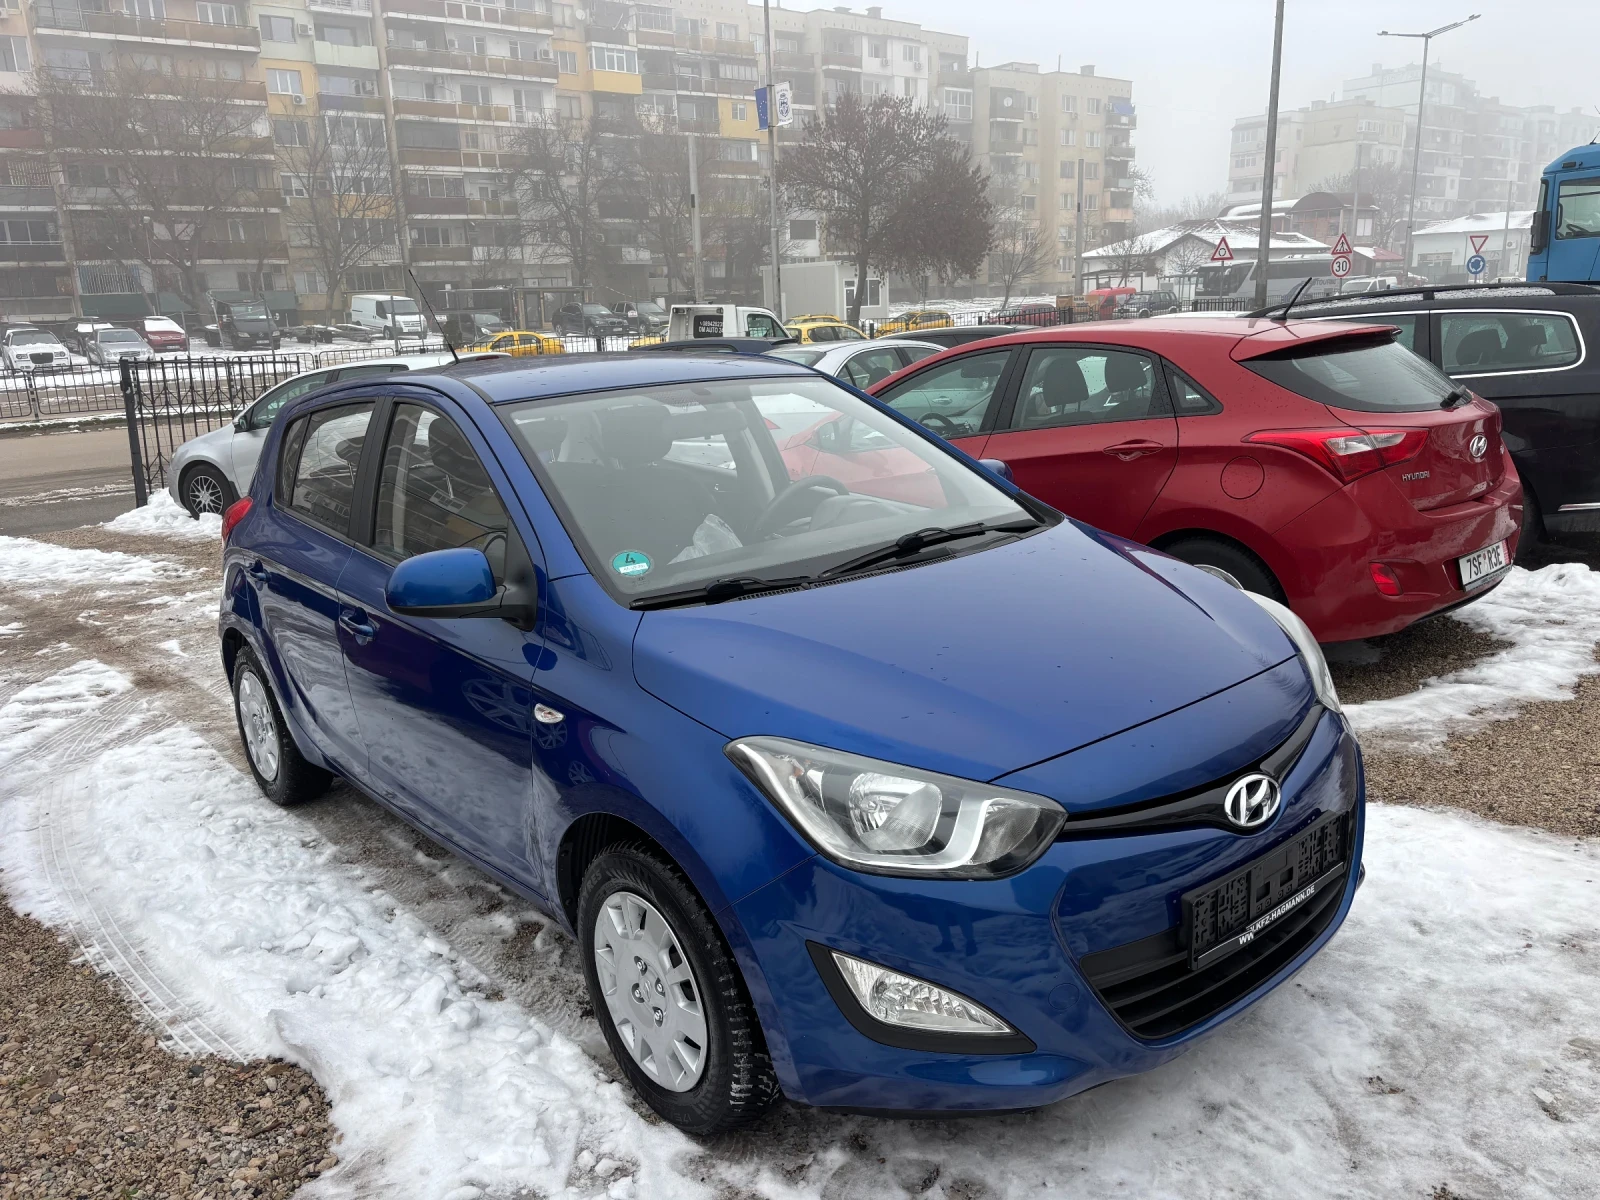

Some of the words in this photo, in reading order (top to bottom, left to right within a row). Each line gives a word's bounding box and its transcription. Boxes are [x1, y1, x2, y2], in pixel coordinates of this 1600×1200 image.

[1335, 260, 1348, 272] 30
[1402, 470, 1430, 482] HYUNDAI
[625, 553, 635, 563] 4
[1466, 553, 1482, 579] 7SF
